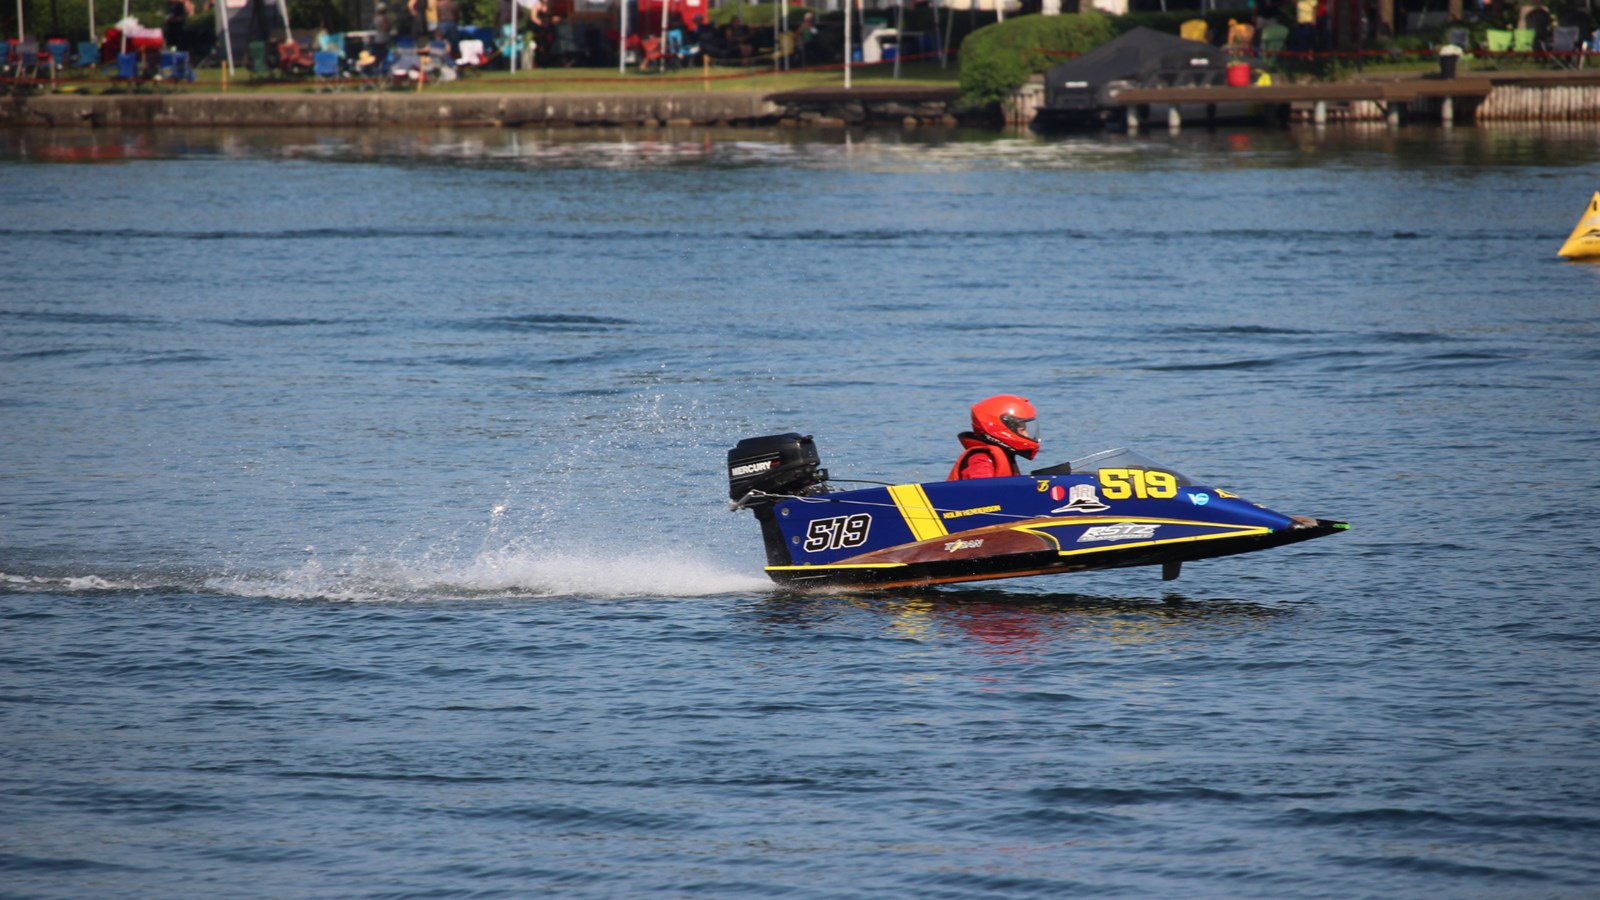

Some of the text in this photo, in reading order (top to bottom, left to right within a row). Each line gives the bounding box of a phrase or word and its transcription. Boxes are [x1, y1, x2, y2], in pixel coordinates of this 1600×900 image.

[731, 461, 772, 476] MERCURY
[1098, 468, 1178, 500] 519
[803, 513, 872, 553] 519
